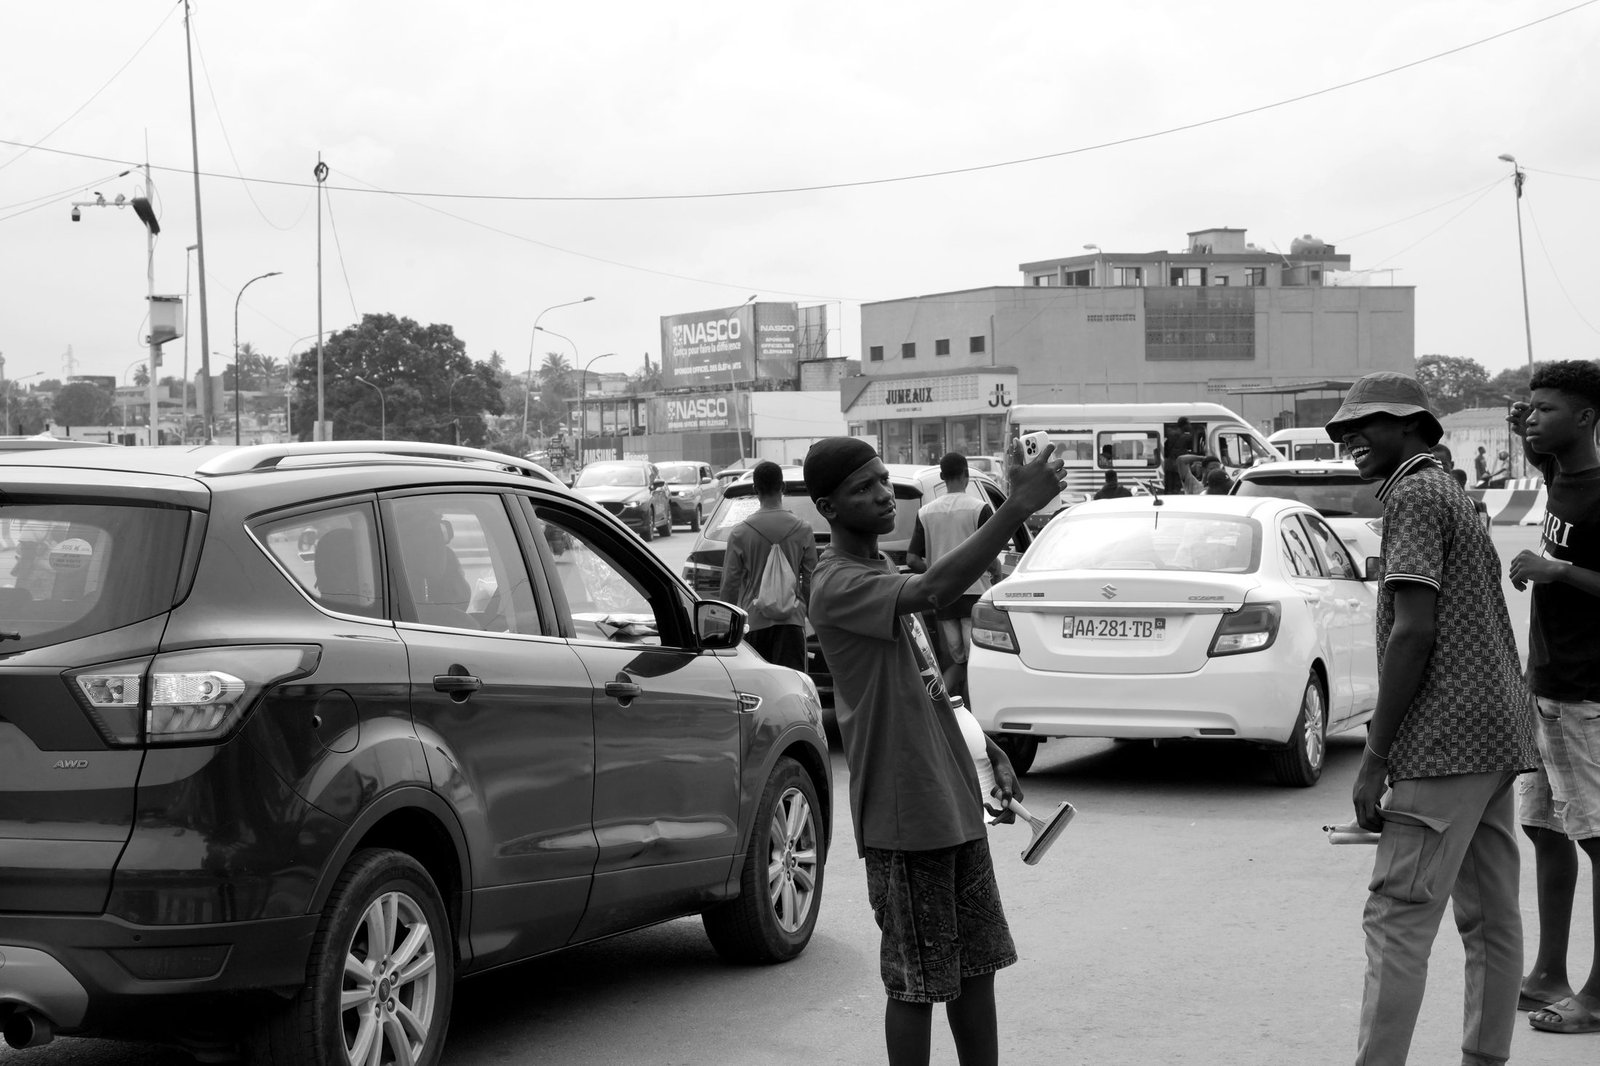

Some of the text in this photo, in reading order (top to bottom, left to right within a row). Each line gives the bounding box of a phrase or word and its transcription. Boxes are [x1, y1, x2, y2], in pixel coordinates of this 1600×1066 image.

[683, 318, 741, 345] NASCO
[676, 398, 728, 419] NASCO
[582, 448, 617, 464] AMSUNG
[1543, 508, 1574, 548] IRI
[53, 759, 89, 769] AWD
